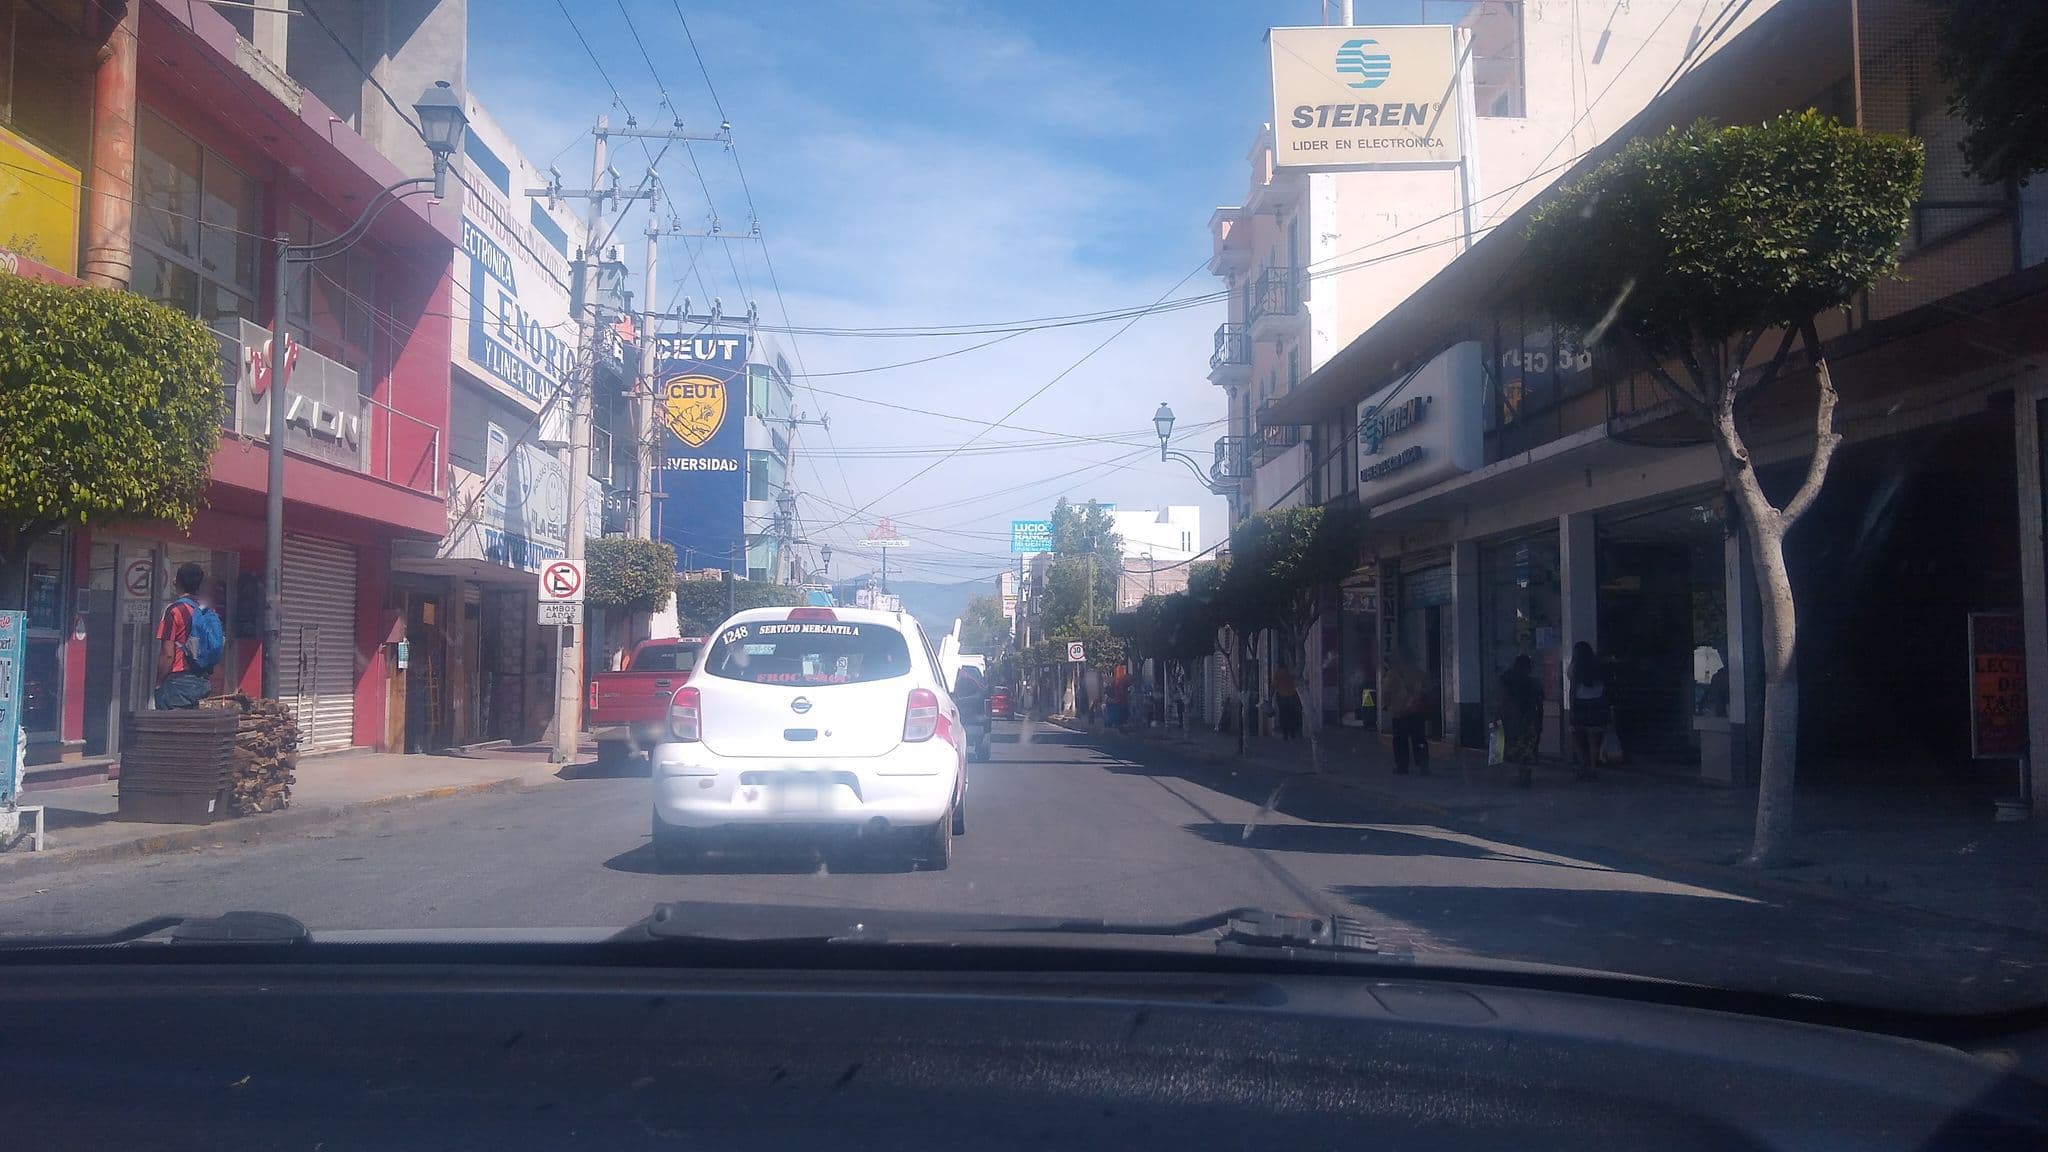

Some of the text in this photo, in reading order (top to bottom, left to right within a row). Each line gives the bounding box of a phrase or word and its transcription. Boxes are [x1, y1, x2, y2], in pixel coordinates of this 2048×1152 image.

[1291, 103, 1428, 129] STEREN
[1292, 137, 1444, 151] LIDER EN ELECTRONICA
[463, 222, 512, 287] ECTRONICA
[653, 338, 739, 361] CEUT
[485, 340, 492, 367] Y
[493, 345, 524, 389] LINEA
[670, 384, 720, 399] CEUT
[651, 457, 739, 472] IVERSIDAD
[1014, 523, 1045, 532] LUCIO
[722, 626, 749, 645] 1248
[759, 624, 800, 636] SERVICIO
[801, 625, 851, 636] MERCANTIL
